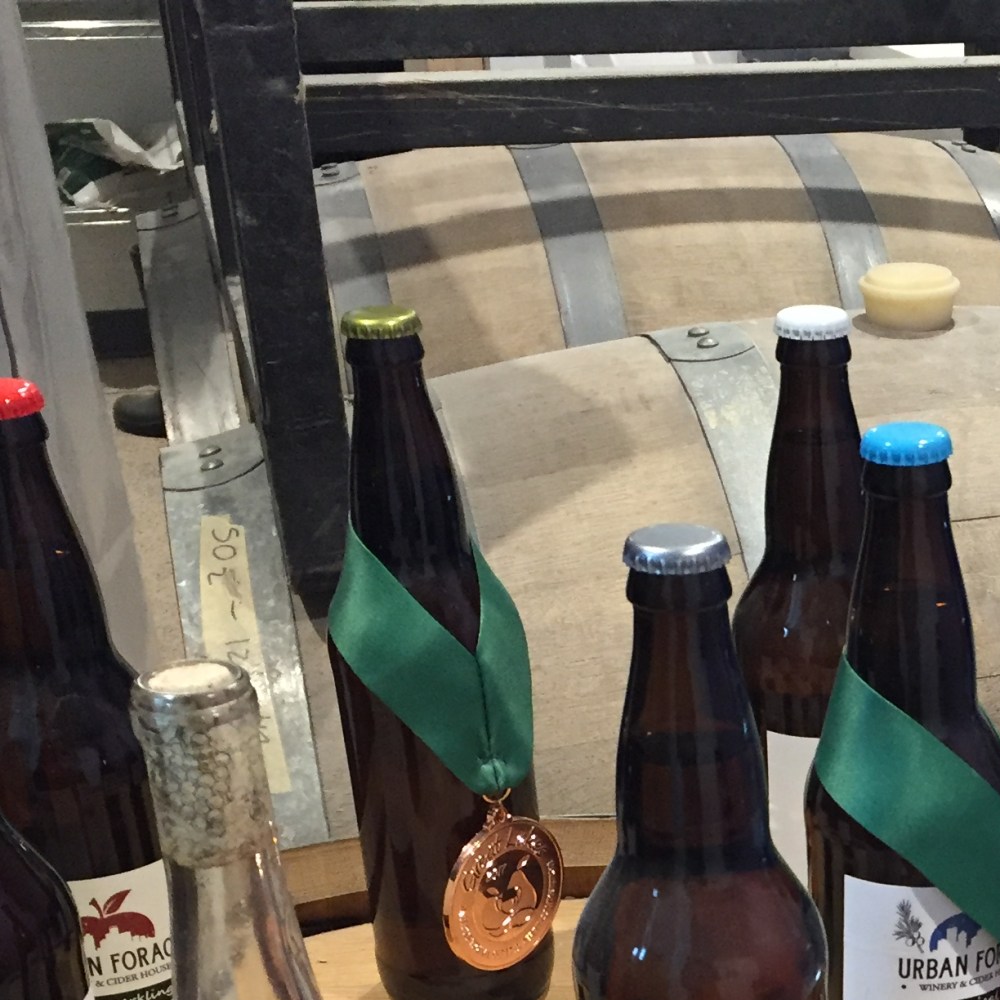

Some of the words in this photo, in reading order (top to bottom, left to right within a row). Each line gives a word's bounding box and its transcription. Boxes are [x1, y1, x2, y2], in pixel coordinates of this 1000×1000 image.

[898, 955, 969, 980] URBAN
[107, 975, 139, 986] CIDER
[919, 981, 958, 992] WINERY
[959, 980, 967, 989] &
